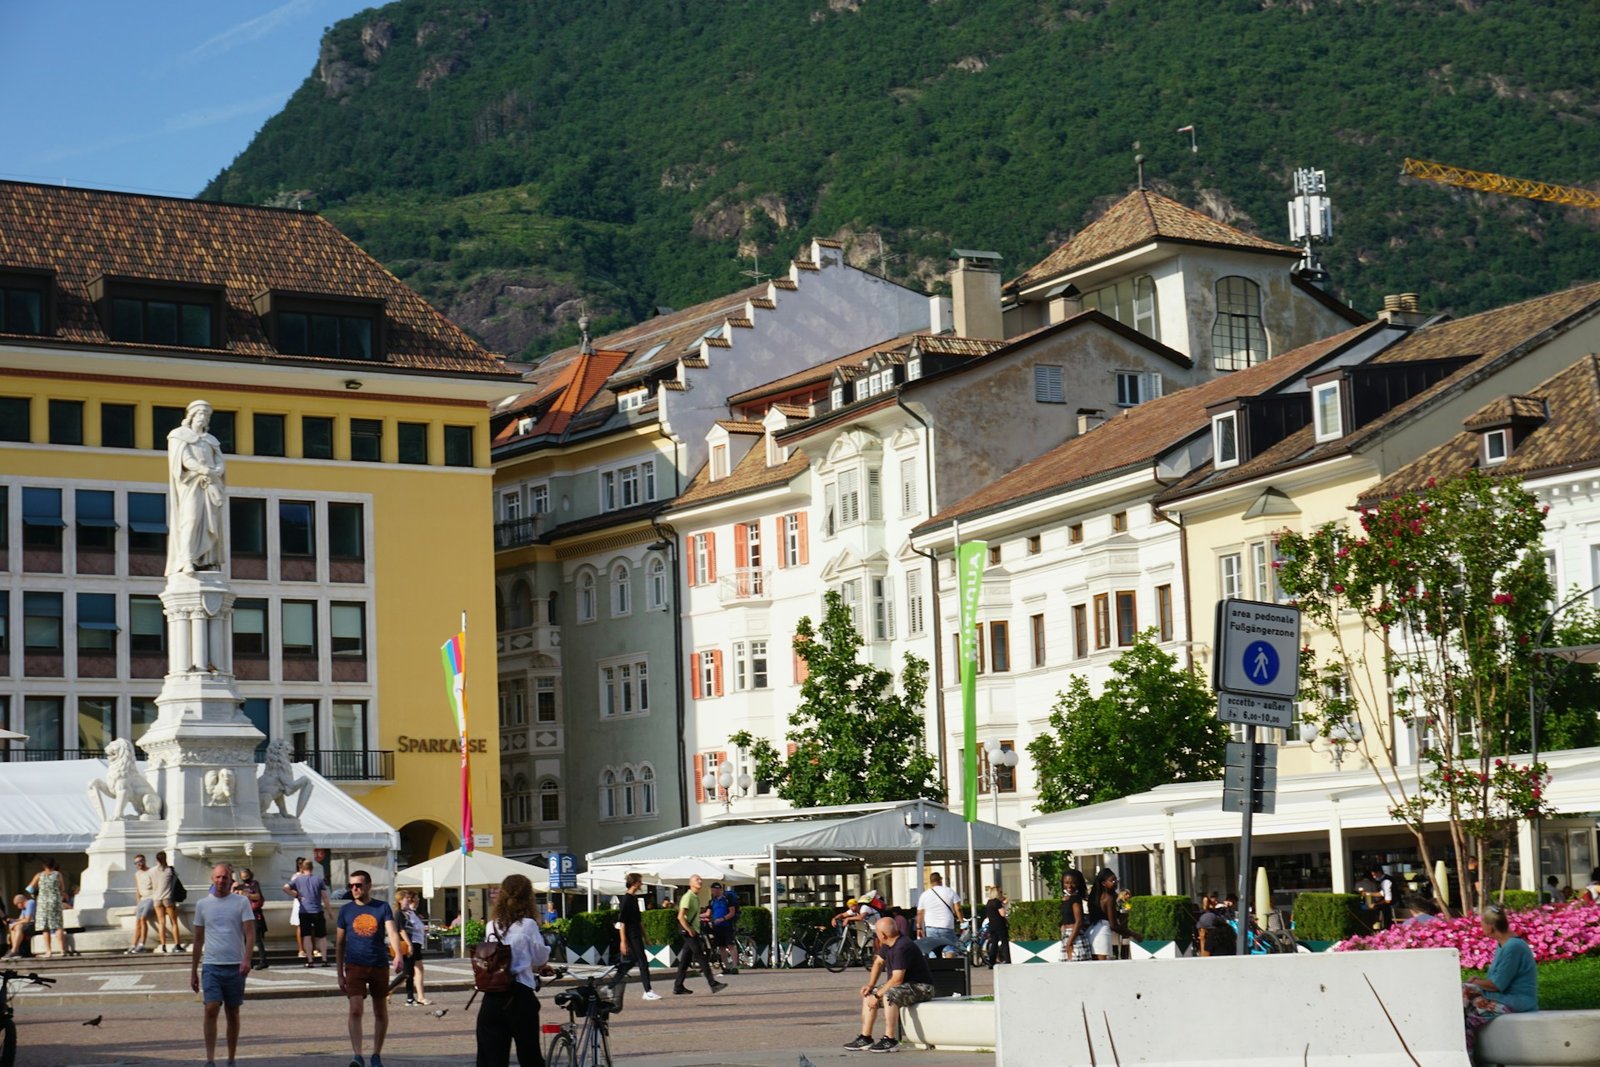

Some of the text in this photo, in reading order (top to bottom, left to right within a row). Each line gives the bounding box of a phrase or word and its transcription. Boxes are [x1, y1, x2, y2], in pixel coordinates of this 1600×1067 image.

[1231, 610, 1295, 624] area pedonale
[1230, 621, 1295, 637] Fußgängerzone
[1227, 697, 1256, 708] eccetto
[1263, 700, 1286, 711] außer
[398, 735, 487, 753] SPARKASE
[561, 859, 573, 874] P
